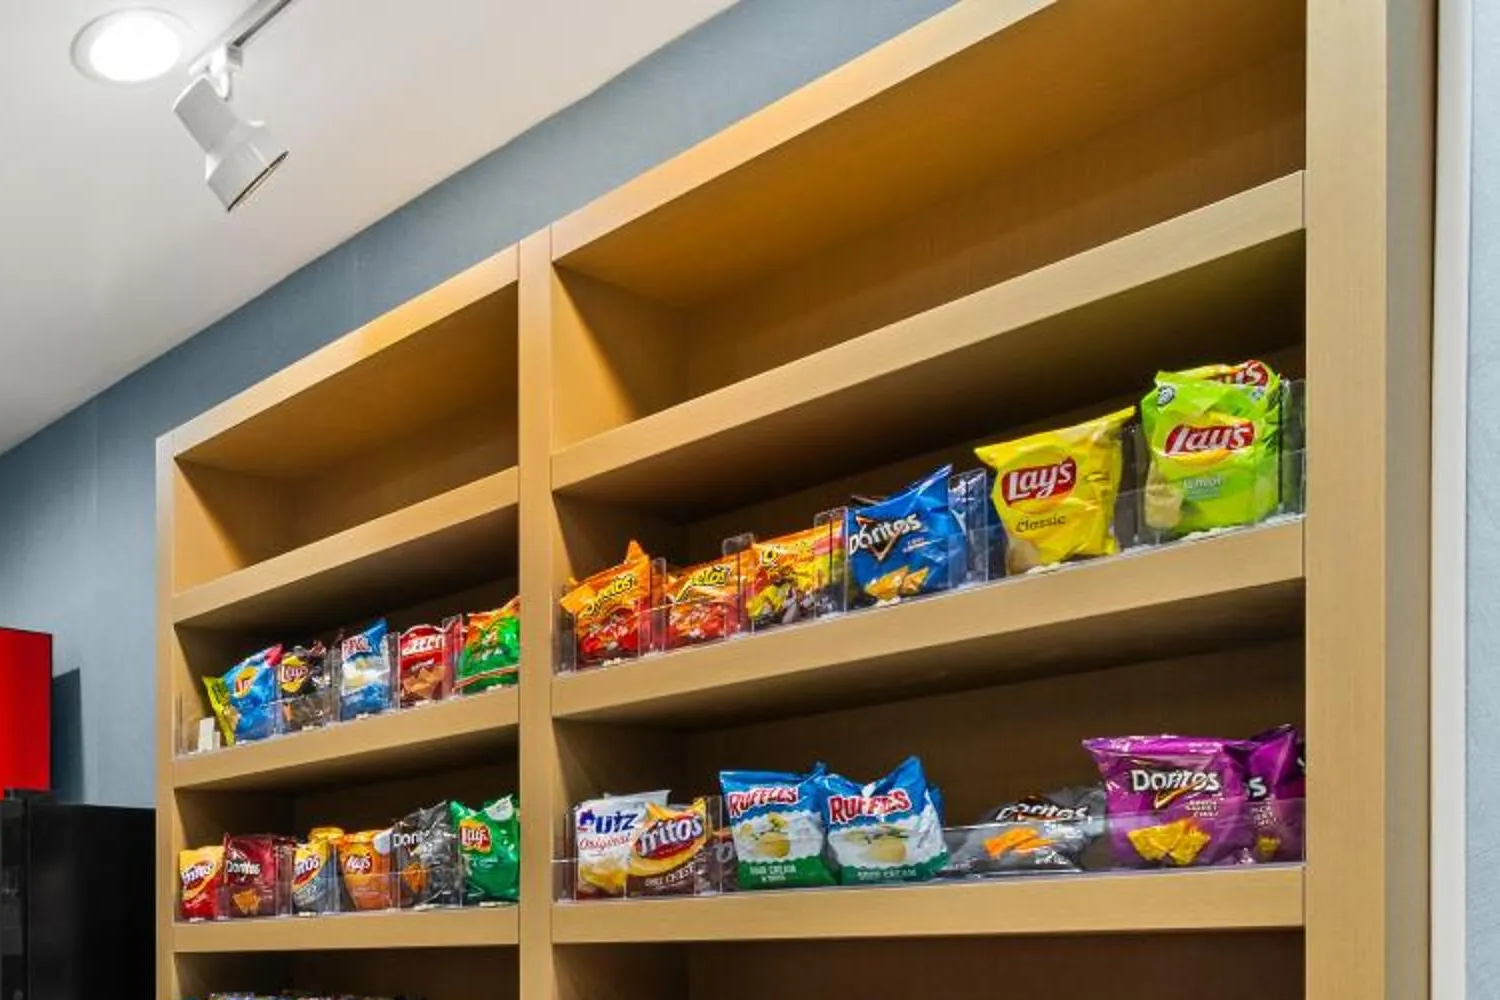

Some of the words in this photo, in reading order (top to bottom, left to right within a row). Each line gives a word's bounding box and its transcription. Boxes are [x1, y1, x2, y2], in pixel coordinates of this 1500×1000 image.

[1166, 423, 1250, 455] Lay's
[1007, 458, 1075, 501] Lay's
[850, 513, 922, 555] Doritos
[1015, 514, 1067, 533] Classic
[1131, 769, 1220, 791] Doritos
[227, 859, 261, 875] Doritos
